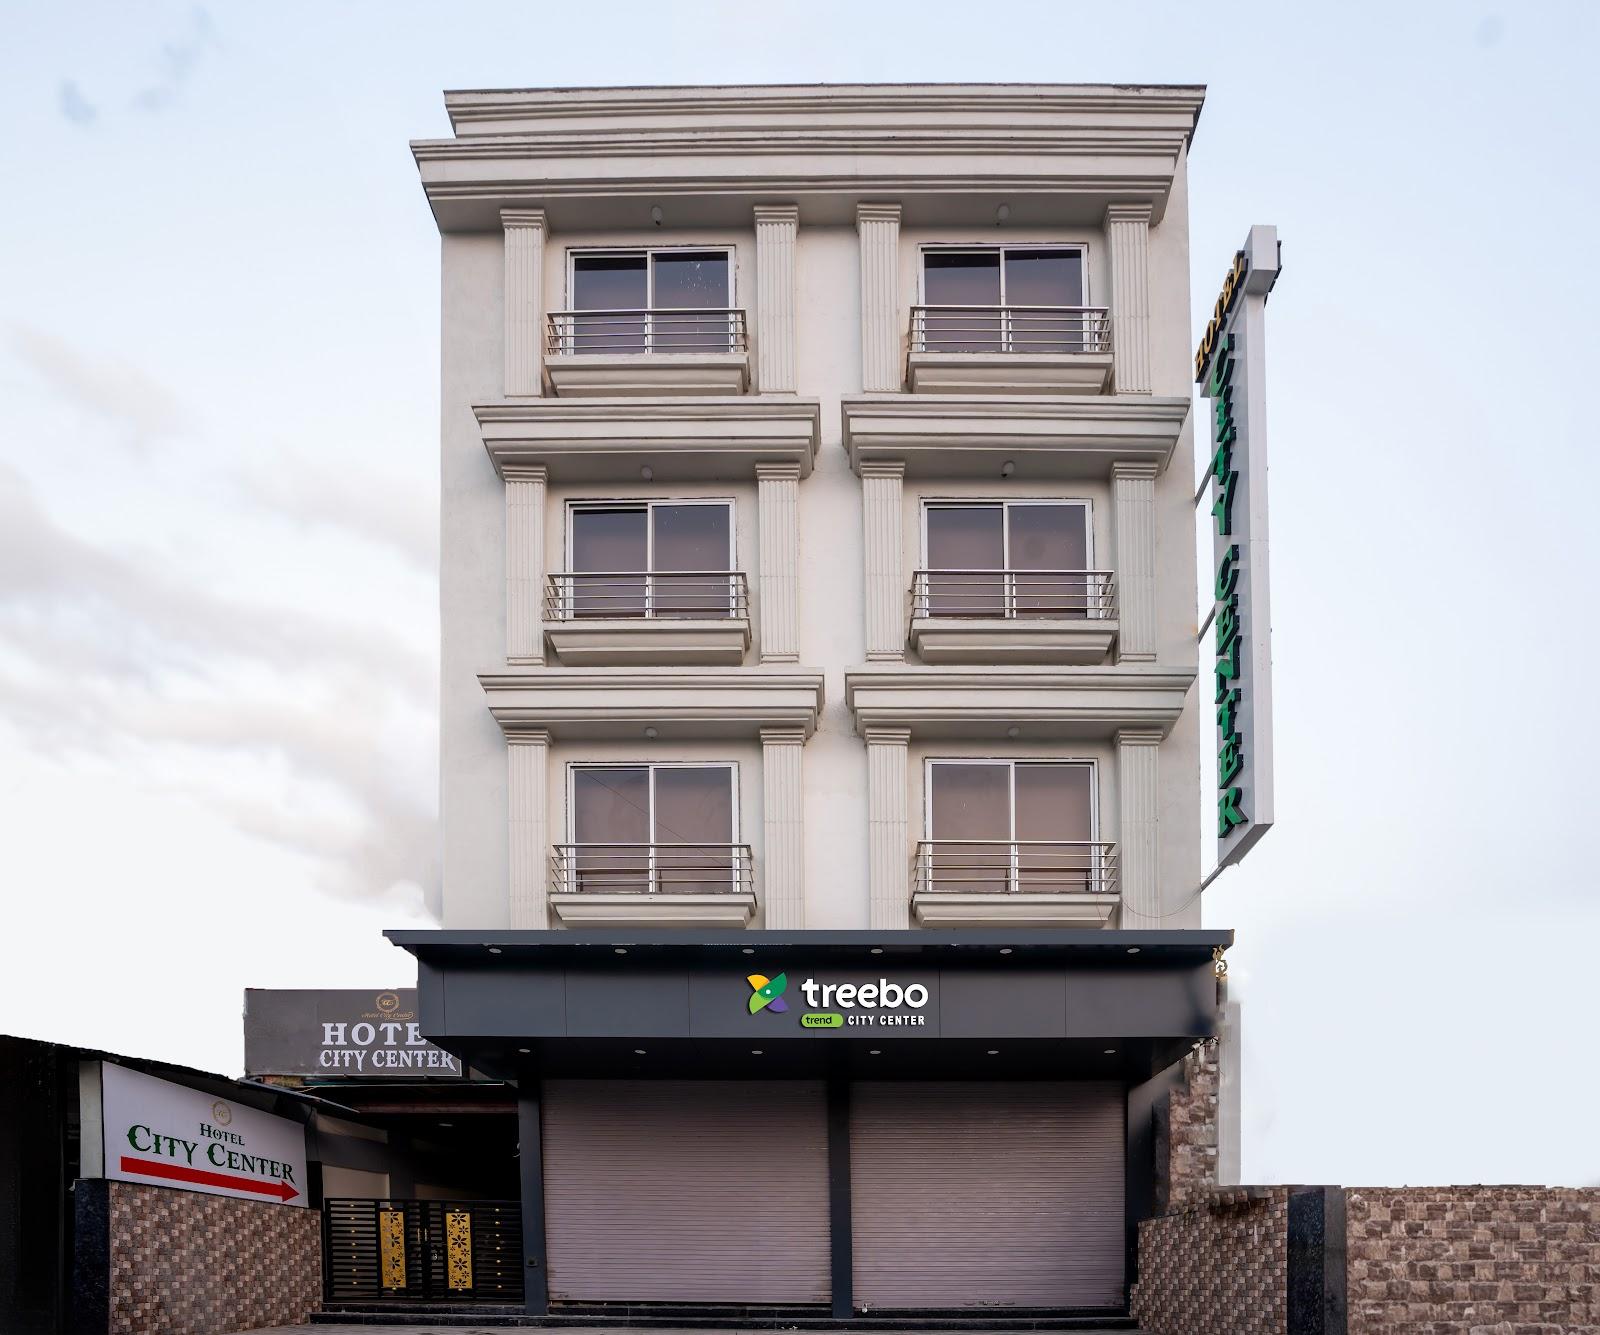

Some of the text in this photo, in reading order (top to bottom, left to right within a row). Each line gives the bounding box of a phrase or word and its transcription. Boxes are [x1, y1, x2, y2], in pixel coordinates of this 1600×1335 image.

[1195, 250, 1248, 382] HOTEL
[1210, 333, 1248, 838] CITY CENTER
[801, 978, 929, 1008] treebo
[805, 1015, 925, 1025] trend CITY CENTER
[321, 1022, 435, 1046] HOTE
[319, 1050, 457, 1072] CITY CENTER
[200, 1123, 245, 1146] HOTEL
[126, 1124, 296, 1185] CITY CENTER
